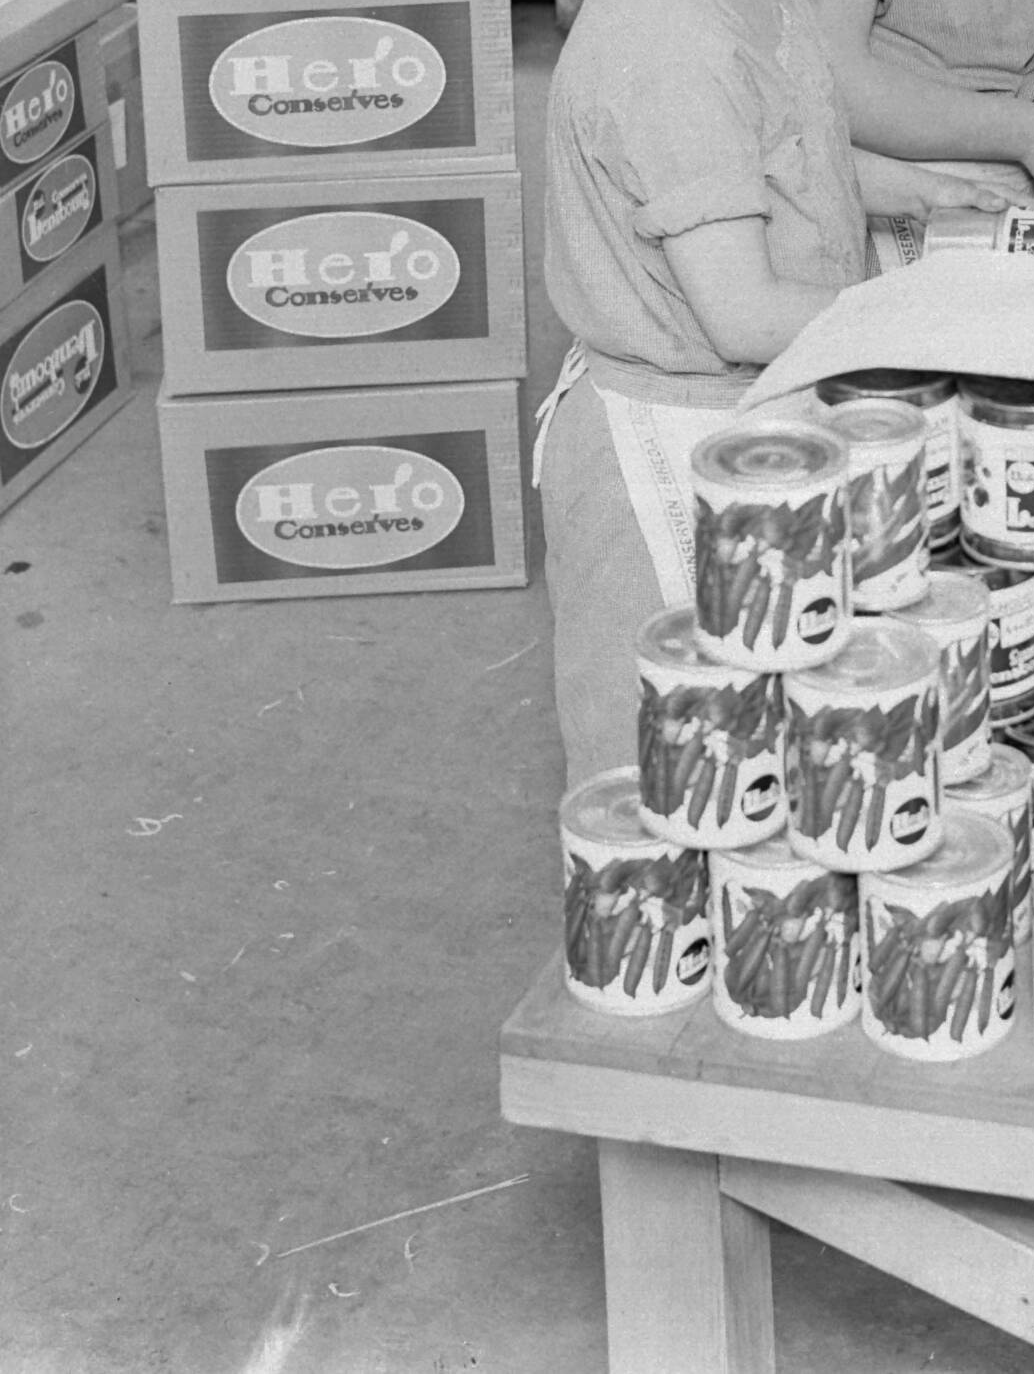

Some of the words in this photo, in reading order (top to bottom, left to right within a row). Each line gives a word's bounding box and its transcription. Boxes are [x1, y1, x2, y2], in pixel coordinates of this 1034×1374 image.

[227, 35, 426, 96] Hero
[2, 70, 69, 138] Hero
[247, 89, 405, 116] Conserves
[245, 229, 441, 288] Hero
[265, 282, 419, 308] Conserves
[254, 463, 445, 522] Hero
[274, 514, 425, 540] Conserves
